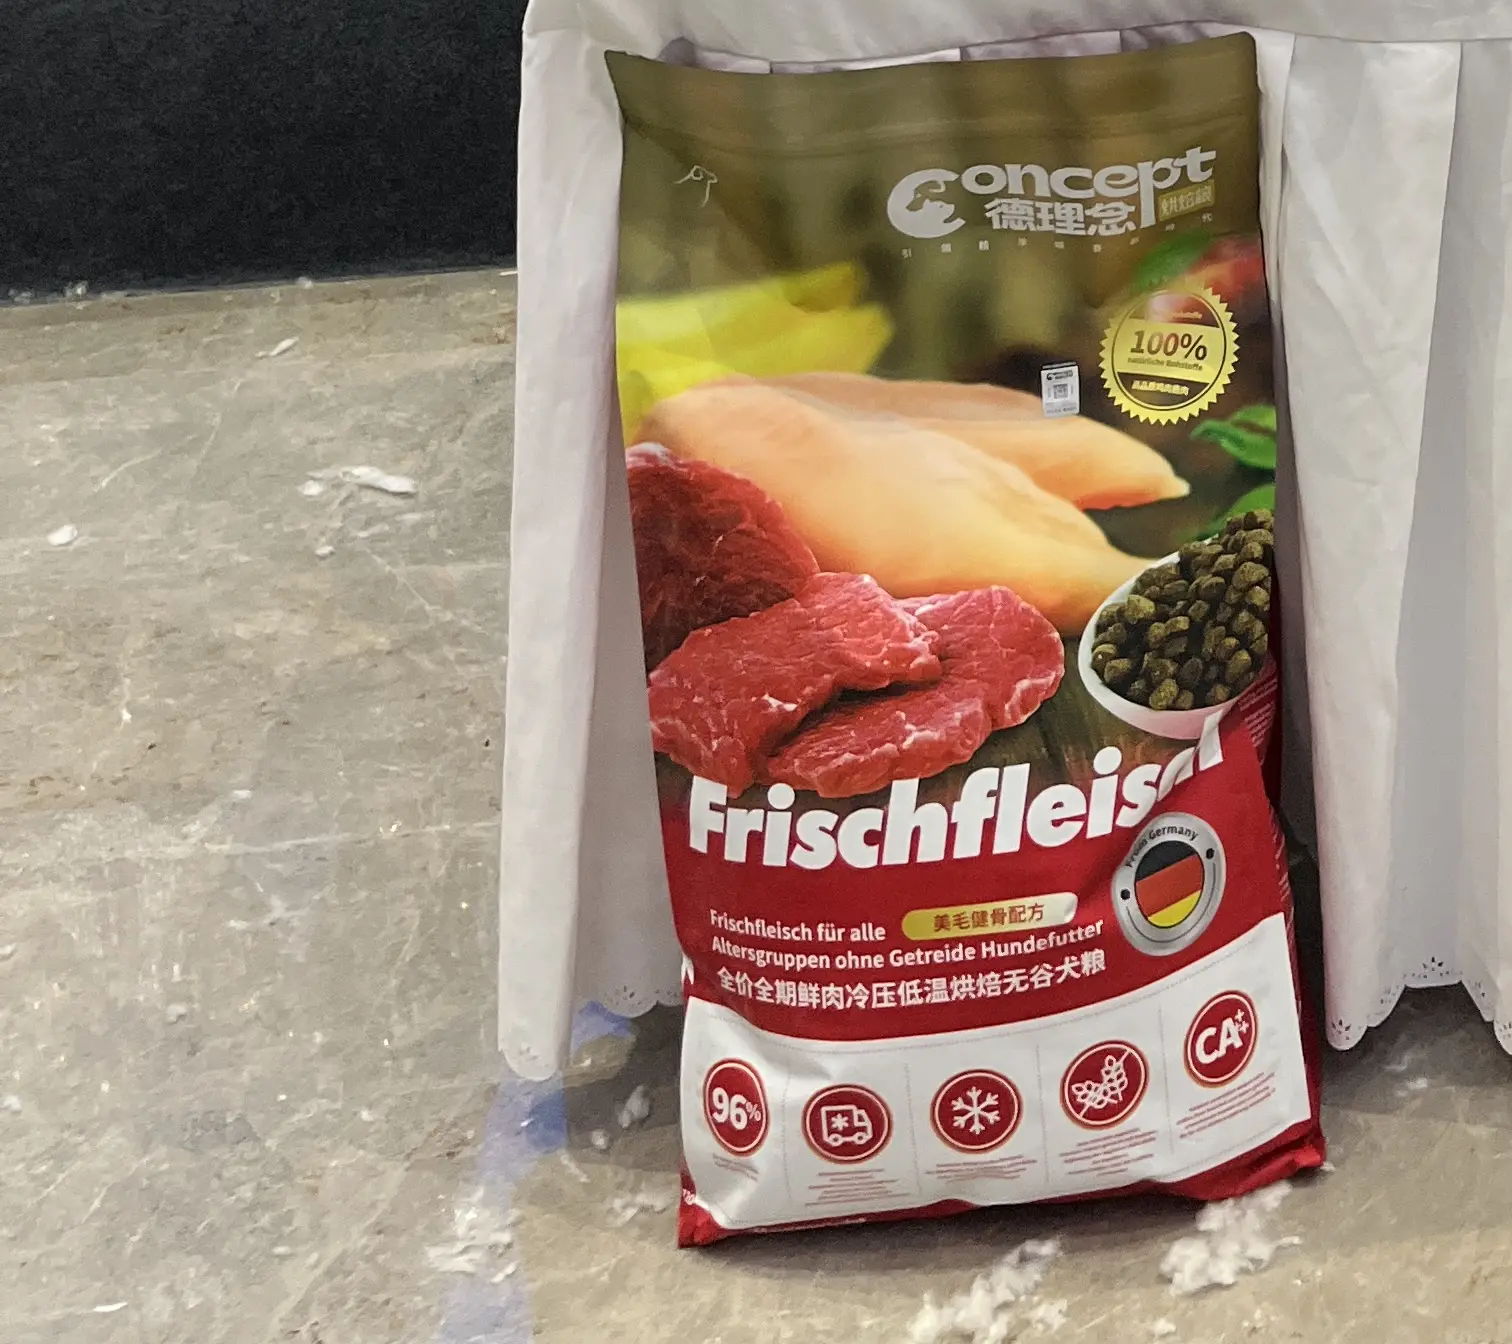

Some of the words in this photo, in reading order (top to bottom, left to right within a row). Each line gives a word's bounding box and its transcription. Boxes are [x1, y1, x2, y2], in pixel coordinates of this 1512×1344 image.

[887, 145, 1218, 238] Concept
[984, 197, 1138, 237] 德理念
[1130, 329, 1208, 361] 100%
[1148, 825, 1199, 842] Germany
[709, 909, 814, 943] Frischfleisch
[816, 920, 846, 942] für
[849, 923, 886, 942] alle
[932, 902, 1045, 933] 美毛健骨配方
[711, 937, 832, 973] Altersgruppen
[834, 951, 884, 970] ohne
[888, 941, 976, 968] Getreide
[980, 919, 1105, 961] Hundefutter
[716, 948, 1107, 1010] 全价全期鲜肉冷压低温烘焙无谷犬粮
[711, 1086, 762, 1131] 96%
